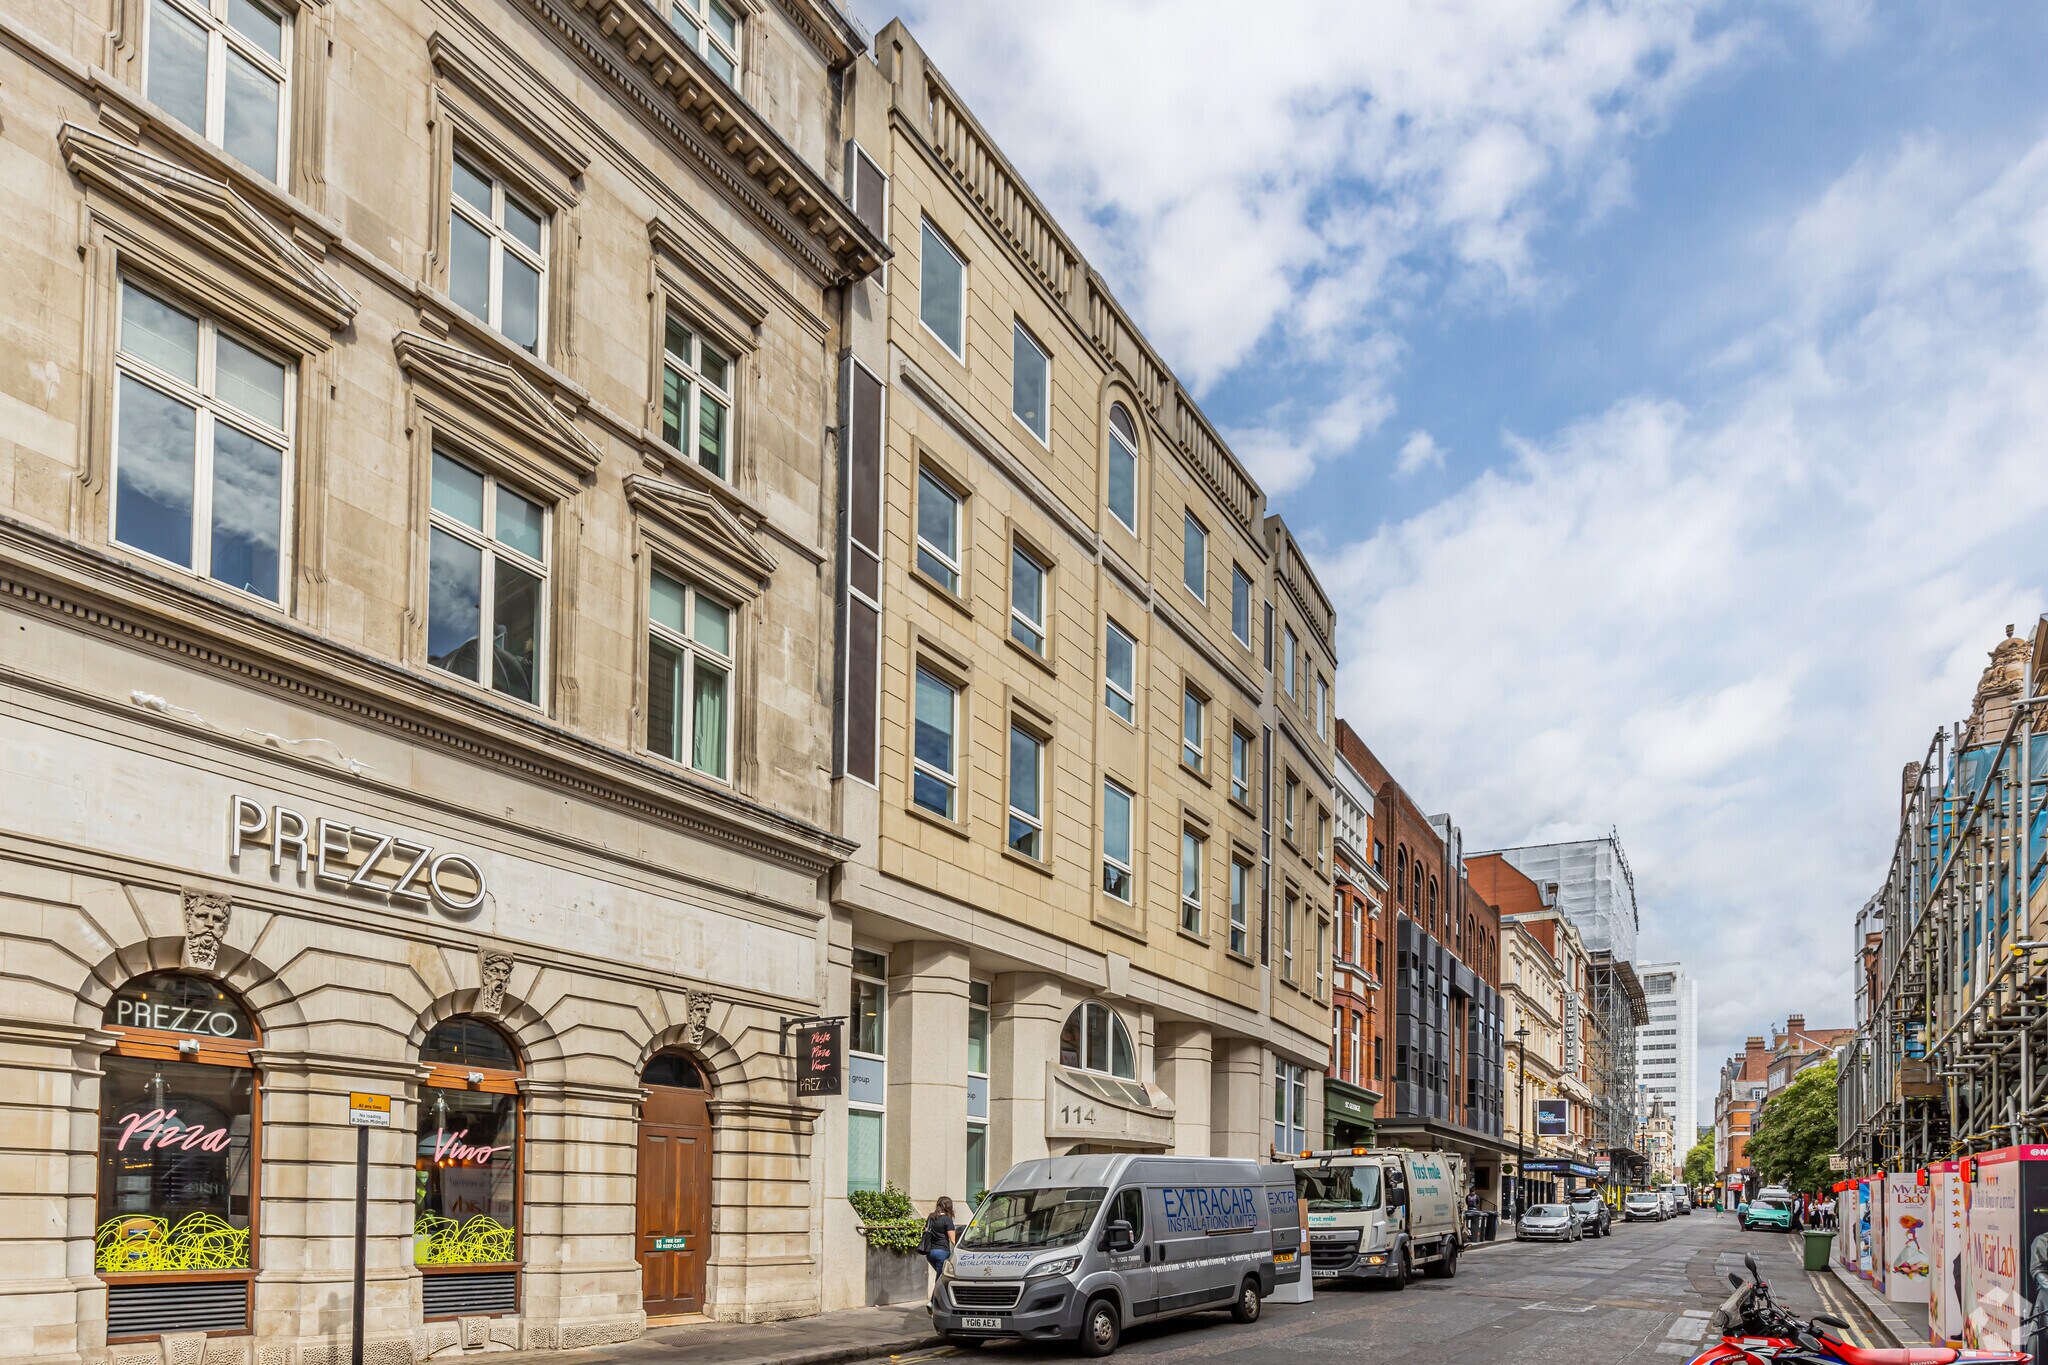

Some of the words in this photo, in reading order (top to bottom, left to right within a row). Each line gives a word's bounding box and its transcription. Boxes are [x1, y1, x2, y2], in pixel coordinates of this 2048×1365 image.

[230, 794, 487, 909] PREZZO
[117, 999, 238, 1037] PREZZO
[1566, 995, 1574, 1025] DUKE
[811, 1031, 831, 1045] Pasta
[811, 1045, 831, 1058] Pizza
[1565, 1033, 1574, 1072] YORK'S
[811, 1059, 831, 1072] Vino
[852, 1075, 870, 1085] group
[1060, 1105, 1096, 1125] 114
[118, 1108, 232, 1153] Pizza
[434, 1127, 511, 1164] Vino
[1412, 1162, 1428, 1179] first
[1427, 1162, 1441, 1179] mile
[1267, 1191, 1296, 1205] EXTR
[1892, 1184, 1912, 1195] My
[1163, 1188, 1256, 1217] EXTRACAIR
[1897, 1193, 1928, 1206] Lady
[1168, 1215, 1229, 1232] INSTALLATIONS
[1230, 1214, 1258, 1228] LIMITED
[960, 1252, 1033, 1260] EXTRACAIR
[1150, 1262, 1180, 1273] Ventilation
[1186, 1259, 1195, 1269] Air
[1196, 1256, 1227, 1268] Conditioning
[1231, 1253, 1251, 1263] Catering
[1251, 1249, 1272, 1260] Equipment
[1973, 1231, 1984, 1279] My
[1984, 1233, 1996, 1273] Fair
[1997, 1234, 2018, 1291] Lady
[965, 1319, 981, 1327] YG16
[982, 1319, 997, 1327] AEX
